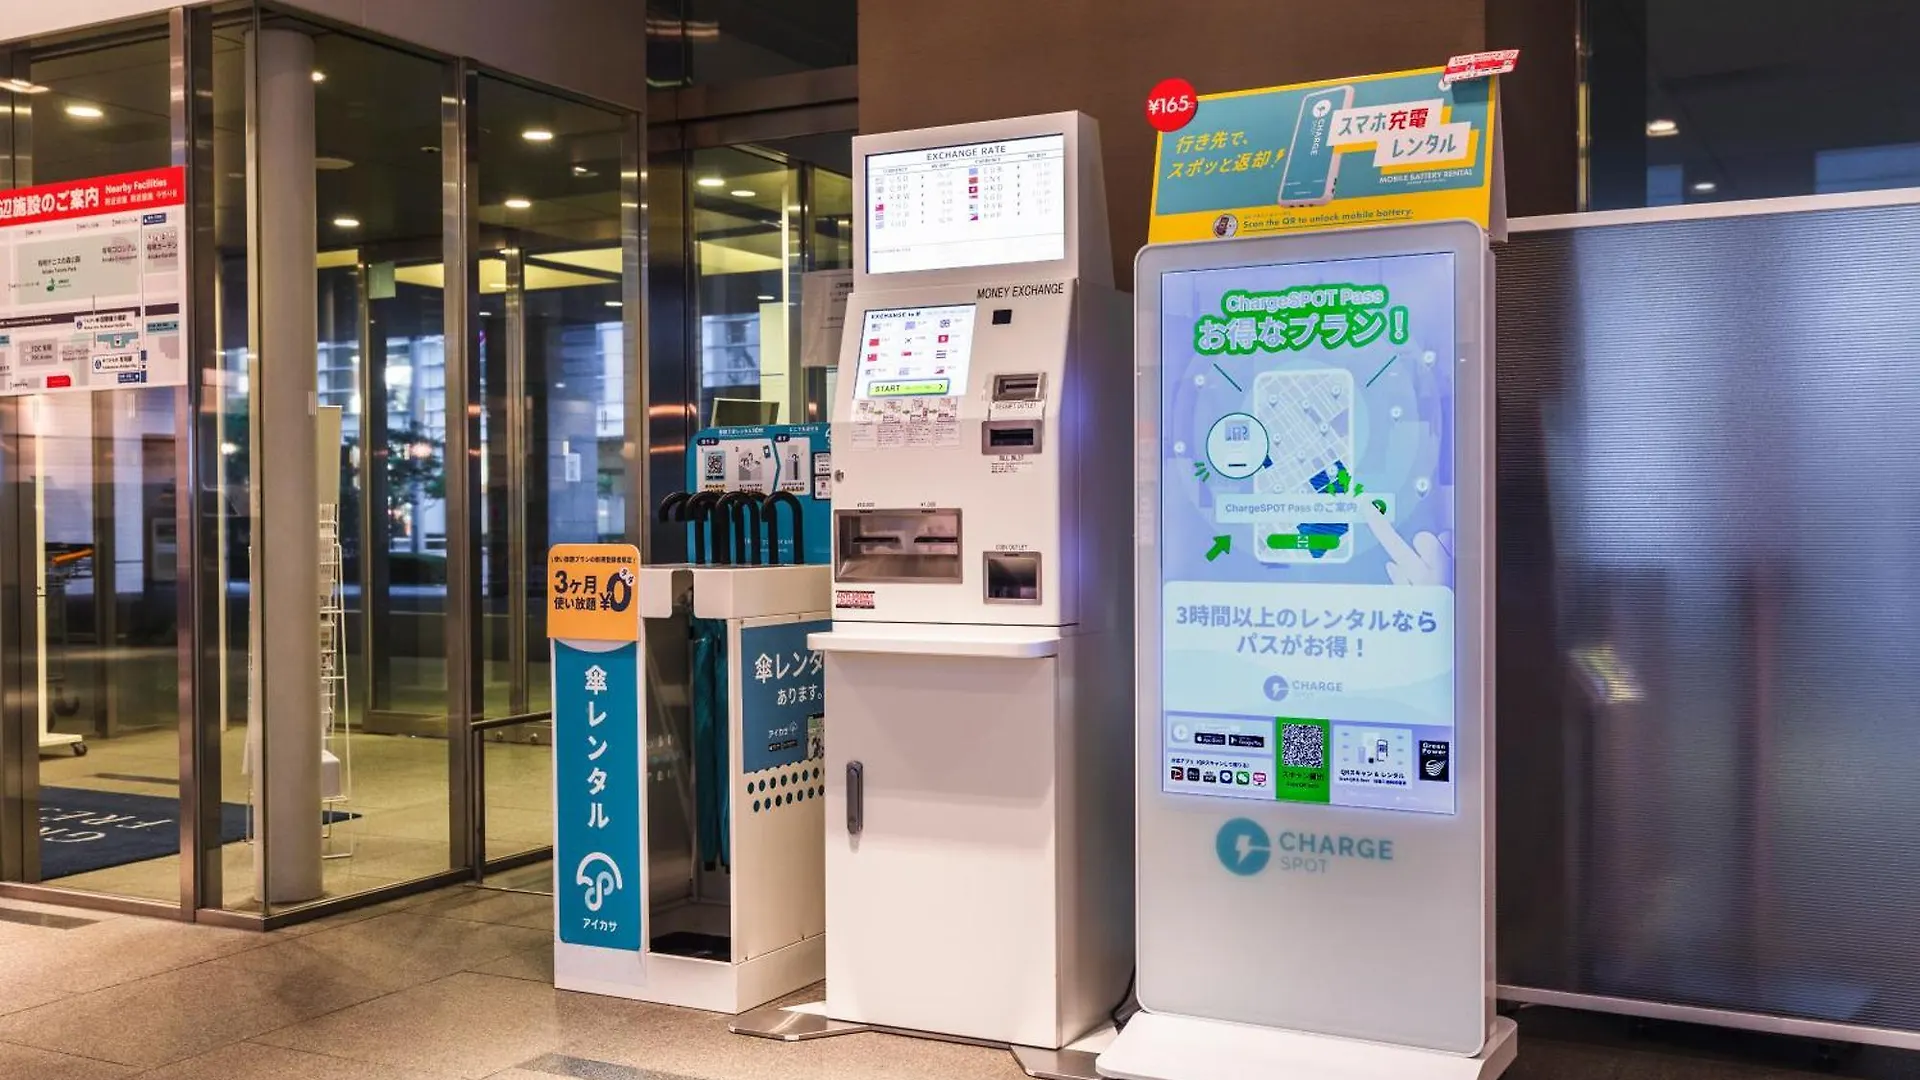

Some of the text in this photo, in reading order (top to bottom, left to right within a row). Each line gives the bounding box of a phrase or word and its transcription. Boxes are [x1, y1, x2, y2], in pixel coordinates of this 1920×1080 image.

[1148, 95, 1188, 115] ¥165
[1338, 108, 1429, 136] スマホ充電
[1176, 131, 1248, 154] 行き先で、
[1310, 118, 1325, 156] CHARGE
[1391, 133, 1457, 158] レンタル
[927, 145, 1006, 160] EXCHANGE RATE
[1380, 175, 1409, 184] MOBILE
[1410, 171, 1441, 180] BATTERY
[1444, 168, 1473, 177] RENTAL
[105, 178, 167, 195] Nearby Facilities
[1243, 220, 1264, 228] Scan
[1282, 217, 1295, 225] QR
[1299, 216, 1307, 224] to
[1310, 214, 1339, 223] unlock
[1342, 211, 1374, 220] mobile
[1376, 208, 1414, 218] battery.
[976, 283, 1064, 299] MONEY EXCHANGE
[1225, 288, 1385, 312] ChargeSPOT Pass
[1199, 309, 1404, 349] お得なプラン！
[875, 384, 900, 392] START
[1226, 502, 1358, 514] ChargeSPOT Pass のご案内
[599, 572, 632, 612] ¥0
[554, 597, 596, 610] 使い放題
[1176, 605, 1437, 633] 3時間以上のレンタルなら
[1236, 634, 1364, 658] パスがお得！
[777, 684, 823, 705] あります。
[1292, 680, 1343, 692] CHARGE
[584, 664, 611, 829] 傘レンタル
[1280, 831, 1394, 860] CHARGE
[1280, 856, 1328, 873] SPOT
[583, 917, 618, 932] アイカサ
